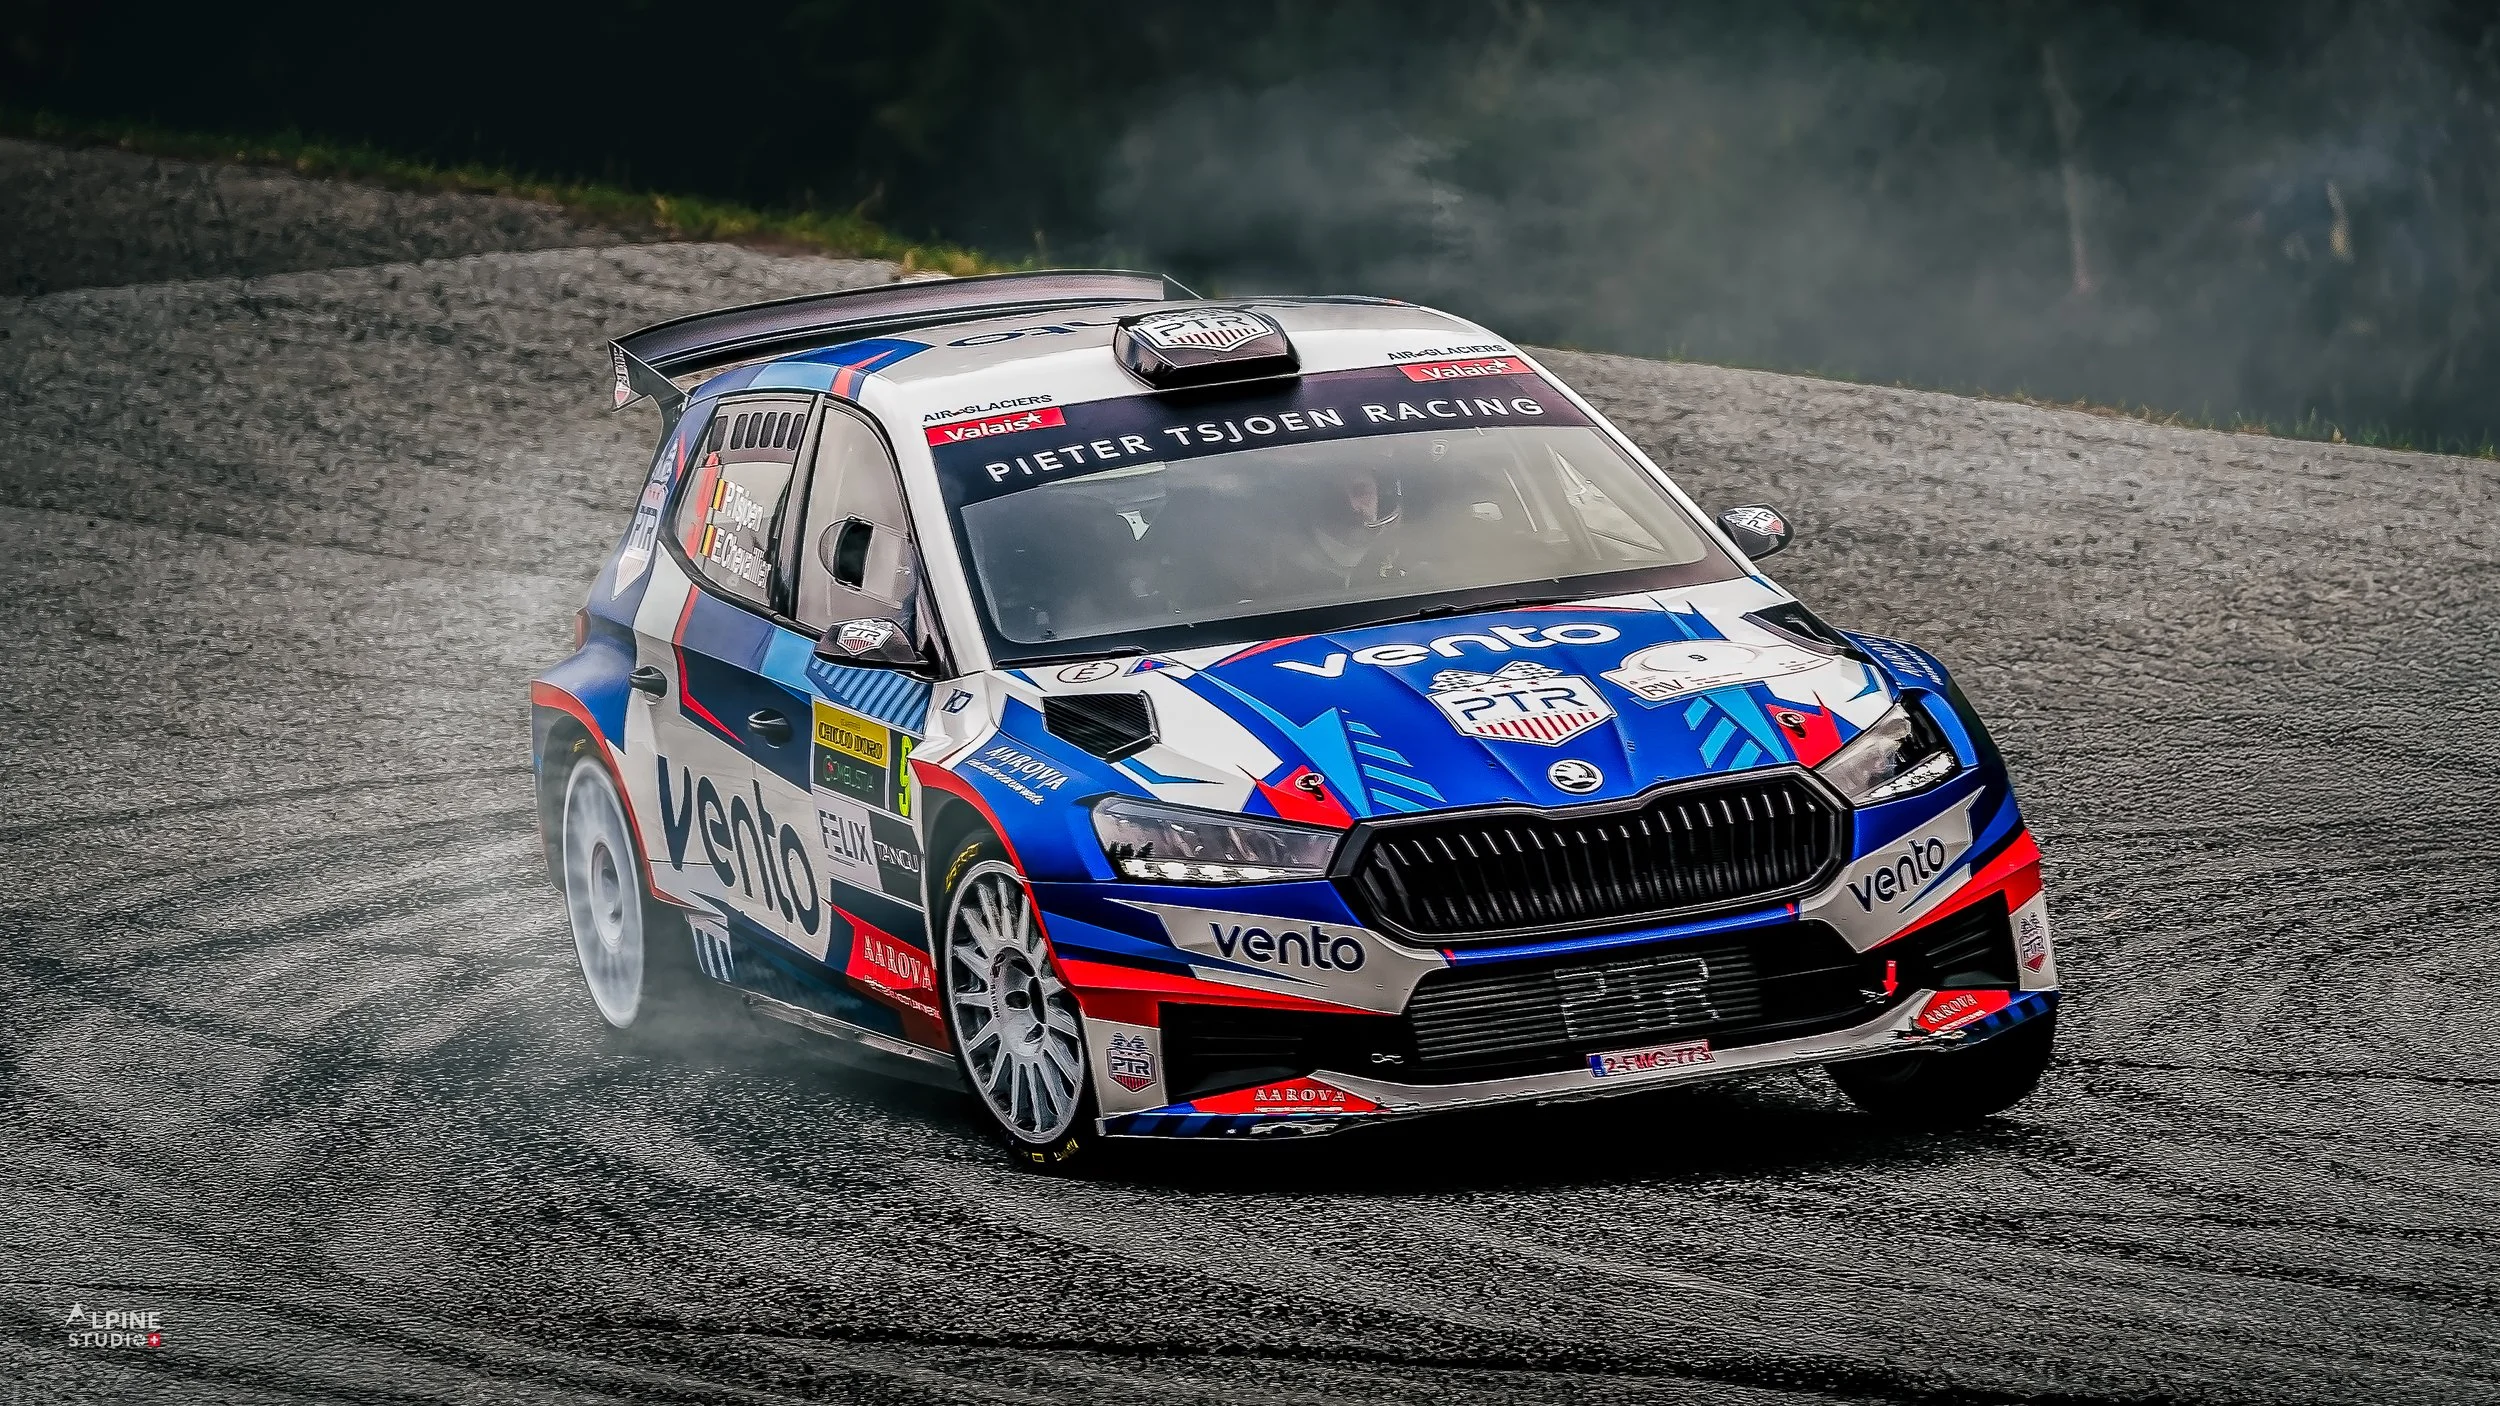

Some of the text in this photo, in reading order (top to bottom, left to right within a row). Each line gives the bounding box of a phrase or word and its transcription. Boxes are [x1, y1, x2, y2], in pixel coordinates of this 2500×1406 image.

[1153, 315, 1250, 336] PTR
[1421, 363, 1503, 380] Valais
[945, 418, 1031, 442] Valais
[985, 397, 1546, 483] PIETER TSJOEN RACING
[1276, 622, 1621, 678] vento
[1451, 687, 1589, 722] PTR
[657, 754, 820, 937] vento
[818, 809, 874, 867] FELIX
[1847, 833, 1947, 914] vento
[864, 934, 934, 992] AAROVA
[1209, 921, 1367, 973] vento
[1553, 955, 1721, 1040] PTR
[1111, 1056, 1150, 1077] PTR
[1254, 1088, 1346, 1102] AAROVA
